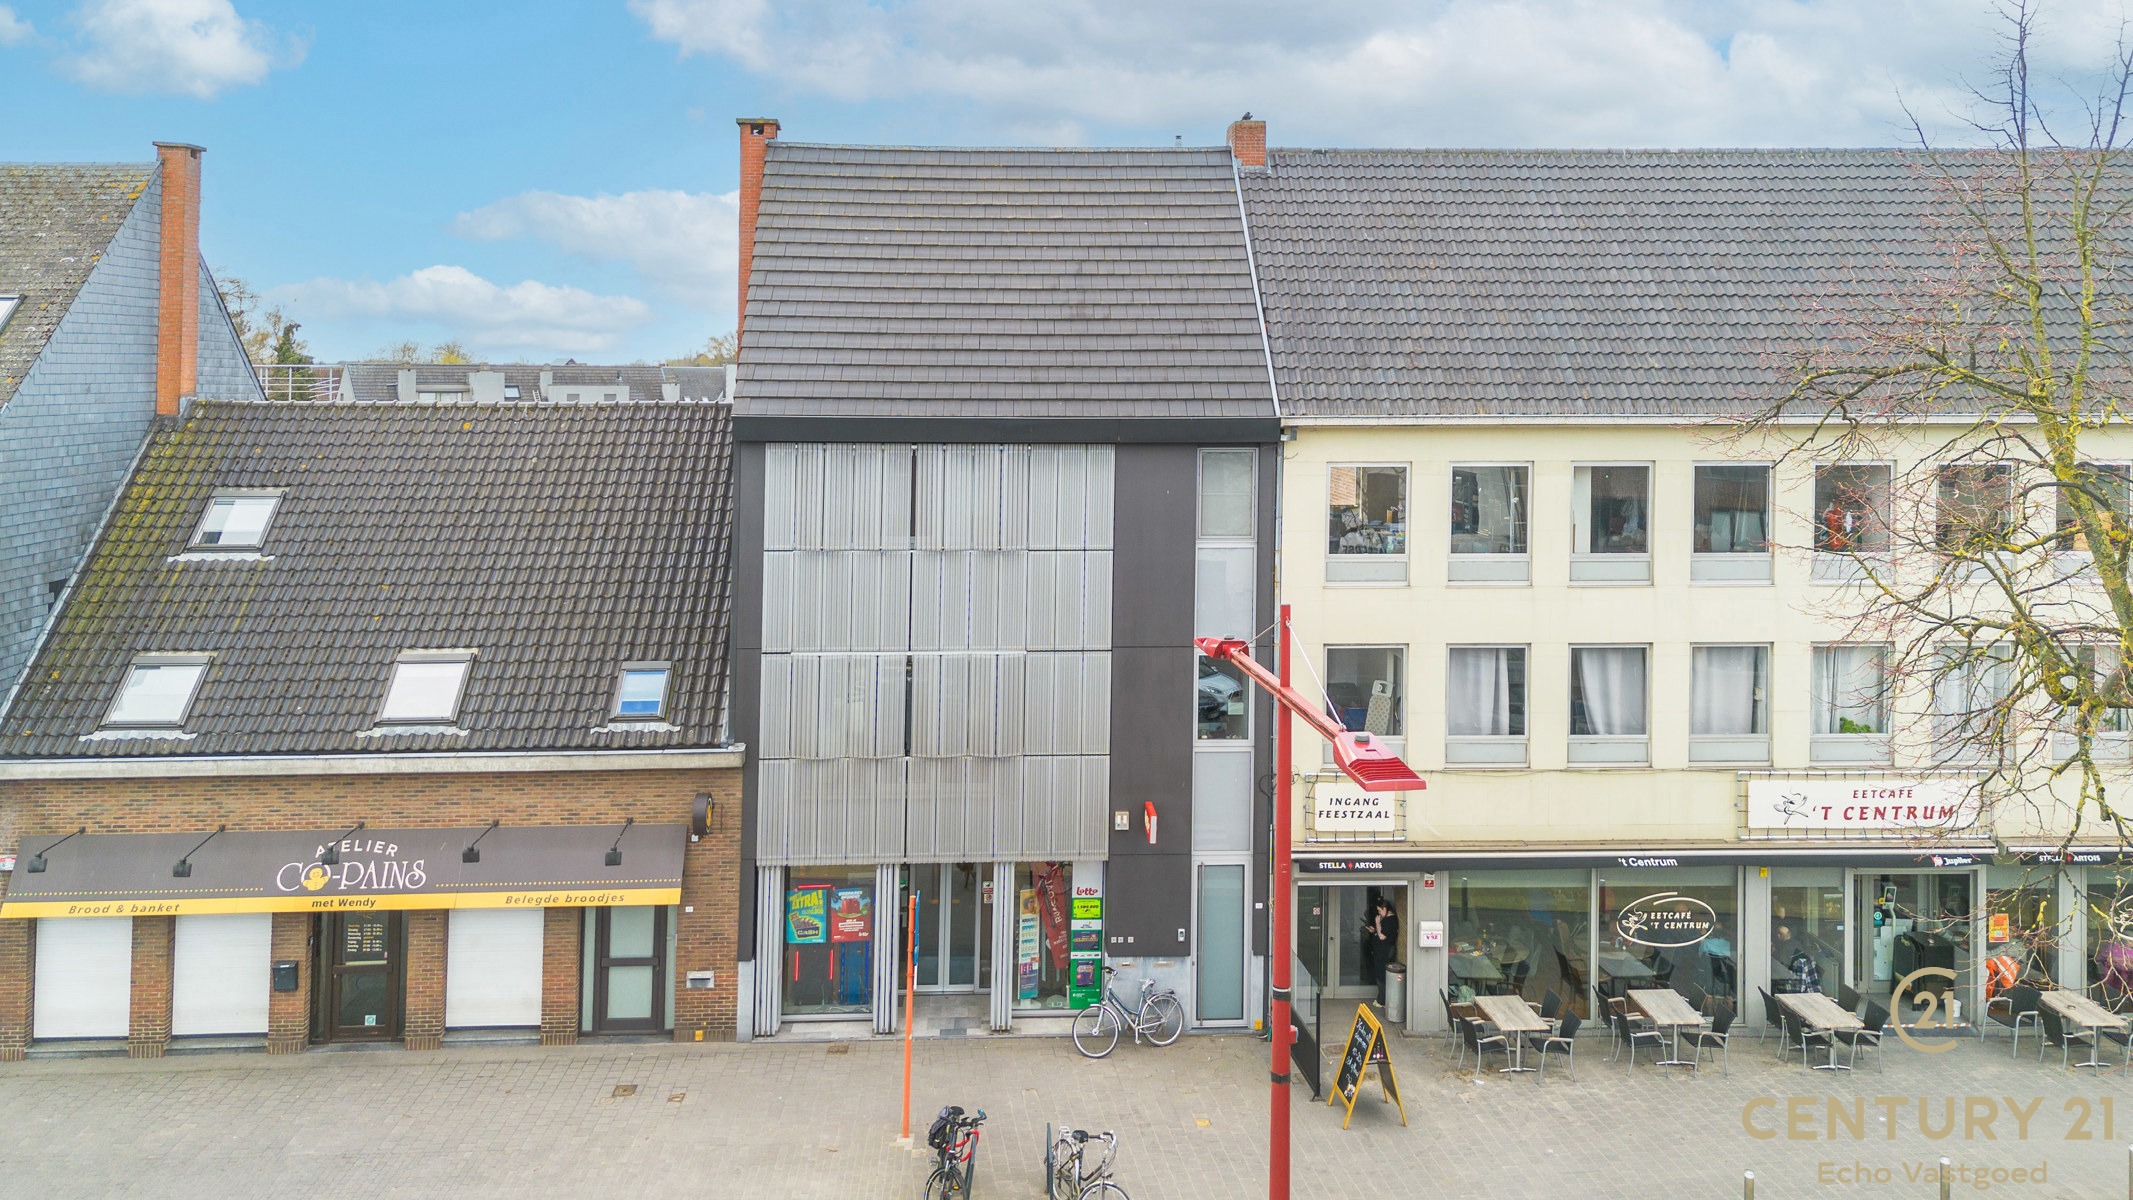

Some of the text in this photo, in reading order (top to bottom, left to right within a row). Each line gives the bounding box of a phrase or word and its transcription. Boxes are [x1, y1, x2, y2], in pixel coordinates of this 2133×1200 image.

[1329, 797, 1380, 806] INGANG
[1318, 810, 1390, 819] FEESTZAAL
[1843, 805, 1954, 821] CENTRUM
[1629, 857, 1678, 867] Centrum
[1943, 856, 1973, 866] Jupiler
[276, 859, 427, 892] CO-PAINS
[311, 898, 377, 908] met Wendy
[505, 894, 625, 906] Belegde broodjes
[68, 904, 180, 914] Brood & banket
[1650, 911, 1692, 920] EETCAFÉ
[1664, 922, 1710, 930] CENTRUM
